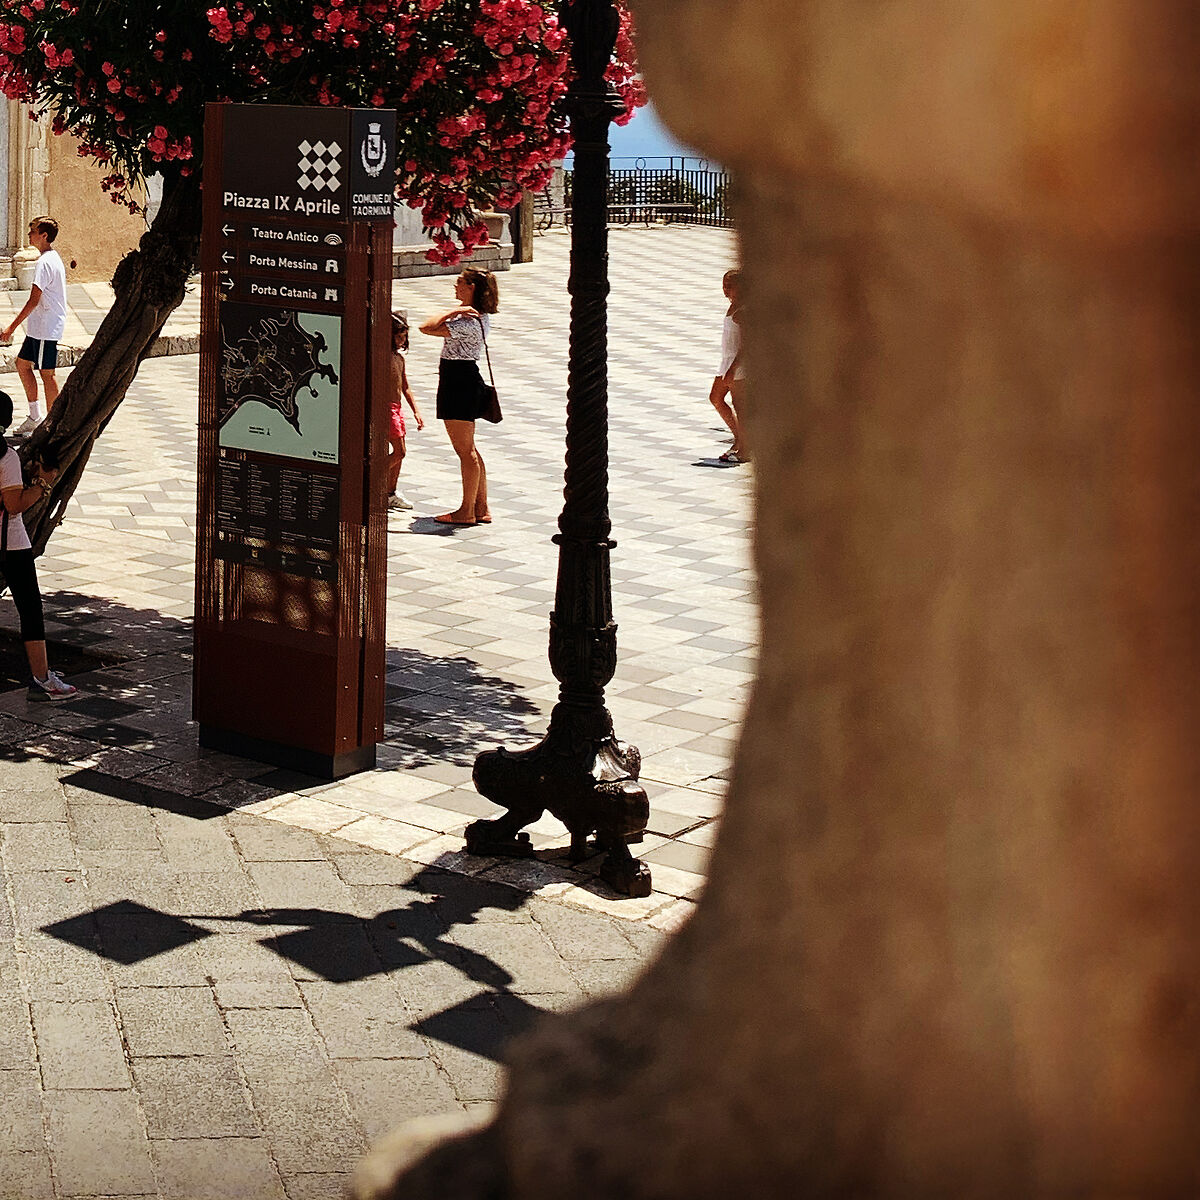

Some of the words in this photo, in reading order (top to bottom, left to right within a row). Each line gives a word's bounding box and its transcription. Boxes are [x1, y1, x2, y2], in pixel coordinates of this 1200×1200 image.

[223, 191, 270, 210] Piazza
[274, 196, 290, 211] IX
[294, 197, 341, 216] Aprile
[352, 194, 383, 204] COMUNE
[384, 194, 391, 204] DI
[352, 205, 391, 216] TAORMINA
[252, 227, 284, 240] Teatro
[286, 230, 319, 243] Antico
[249, 255, 276, 267] Porta
[278, 257, 318, 271] Messina
[251, 284, 277, 296] Porta
[279, 286, 318, 300] Catania
